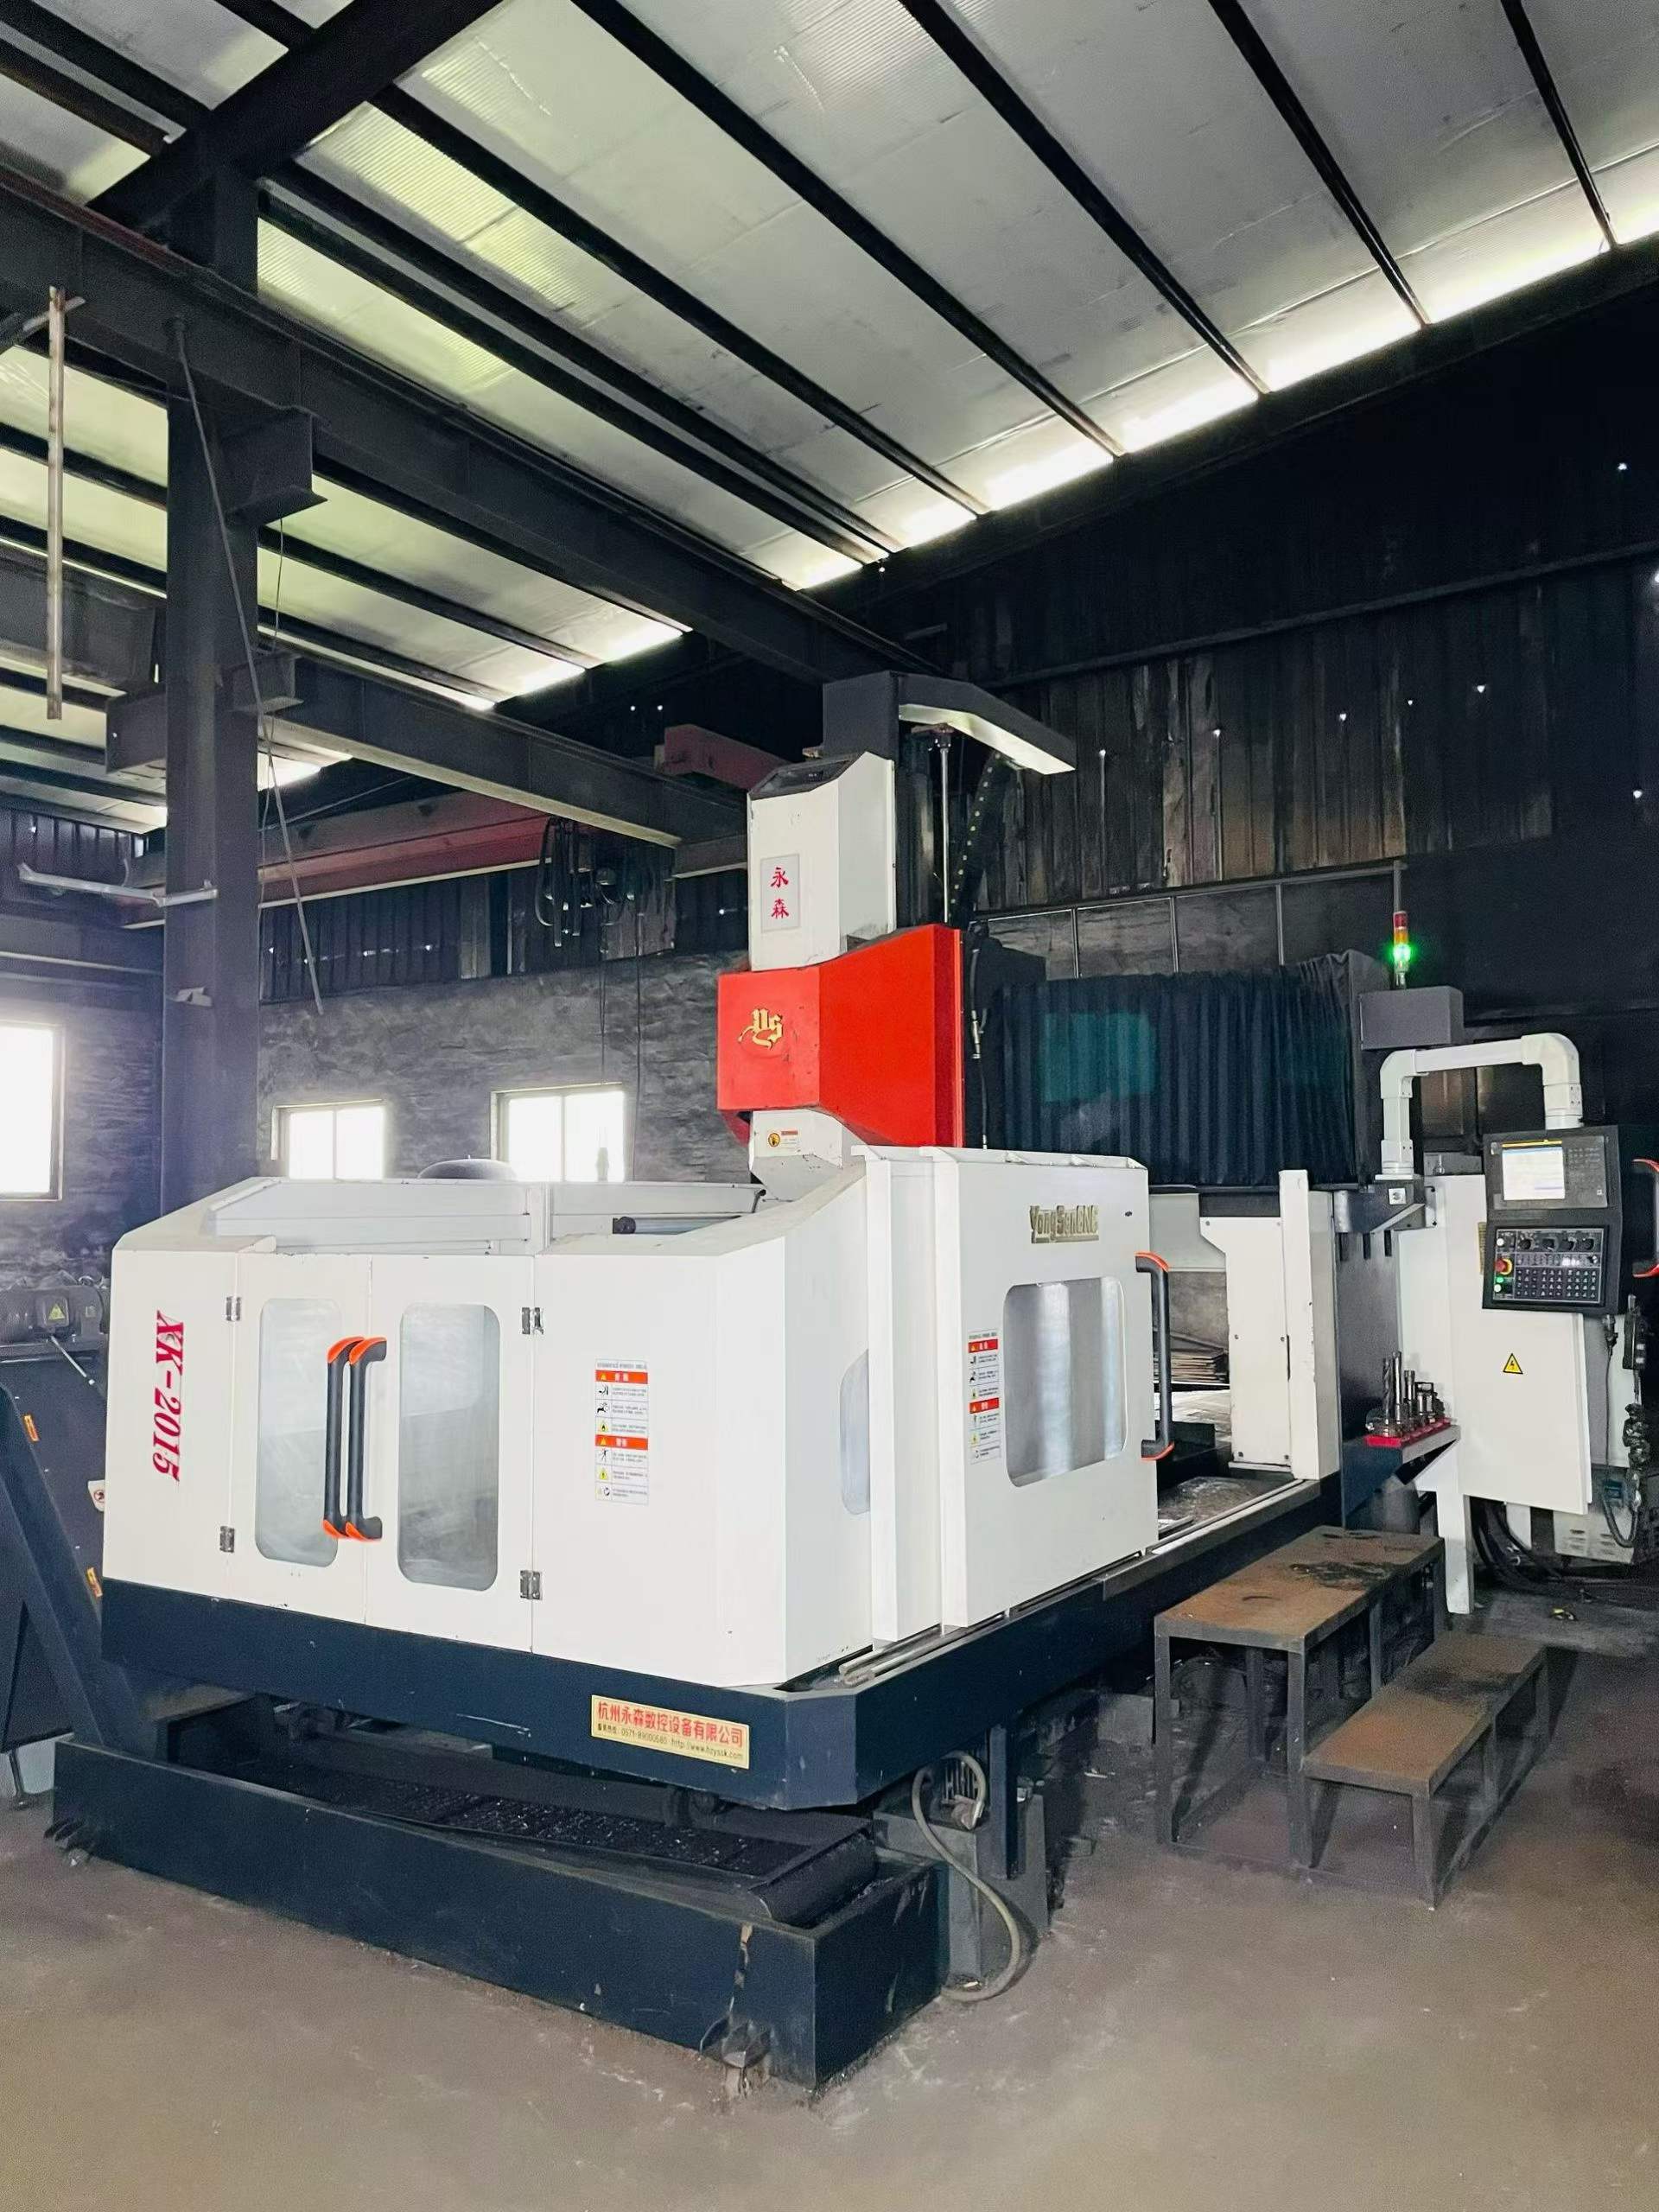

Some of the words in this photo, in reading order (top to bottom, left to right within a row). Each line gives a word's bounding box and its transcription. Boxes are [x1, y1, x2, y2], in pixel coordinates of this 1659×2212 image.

[771, 867, 789, 918] 永森
[153, 1310, 184, 1482] XK-2015
[598, 1700, 743, 1747] 杭州永森数控设备有限公司
